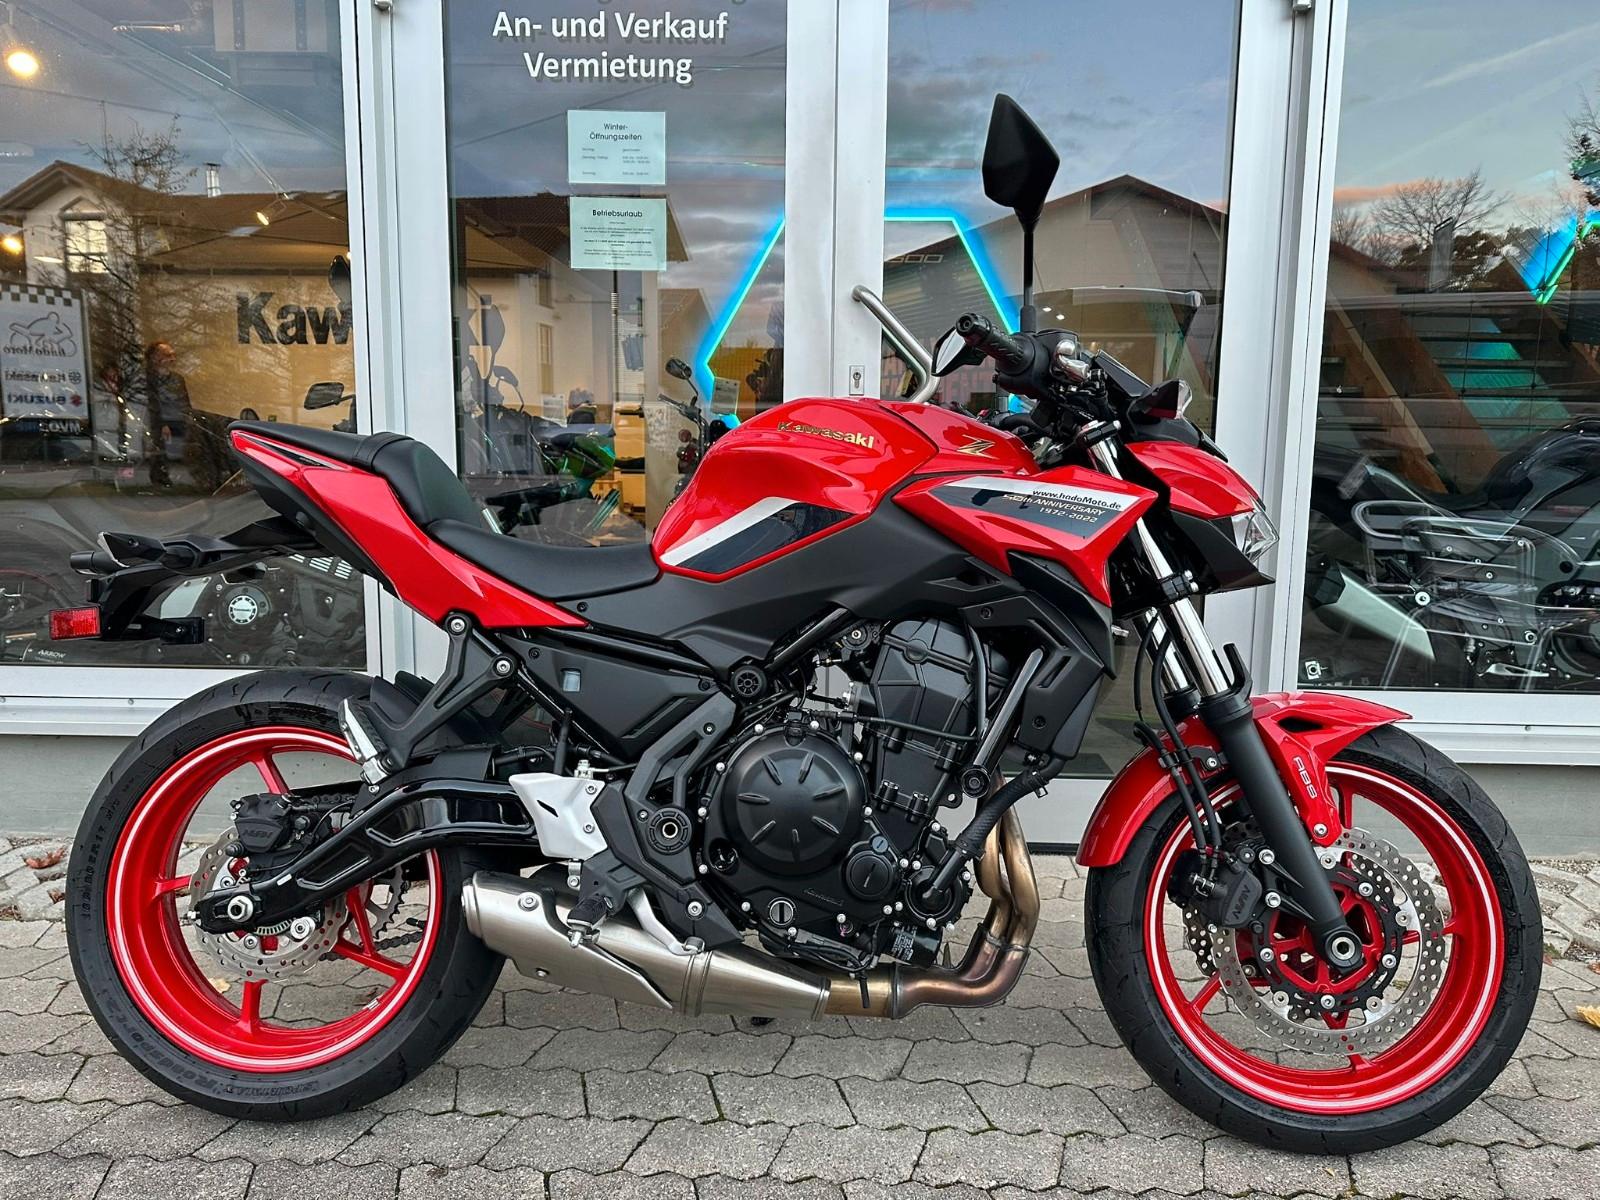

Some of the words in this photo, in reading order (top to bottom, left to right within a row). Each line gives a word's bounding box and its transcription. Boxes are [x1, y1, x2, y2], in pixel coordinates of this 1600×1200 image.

[492, 11, 542, 37] An-
[551, 11, 606, 37] und
[614, 12, 729, 39] Verkauf
[523, 51, 693, 84] Vermietung
[603, 122, 628, 131] Winter-
[589, 131, 642, 142] Öffnungszeiten
[592, 209, 643, 218] Betriebsurlaub
[776, 421, 875, 449] Kawasaki
[1033, 498, 1106, 516] ANNIVERSARY
